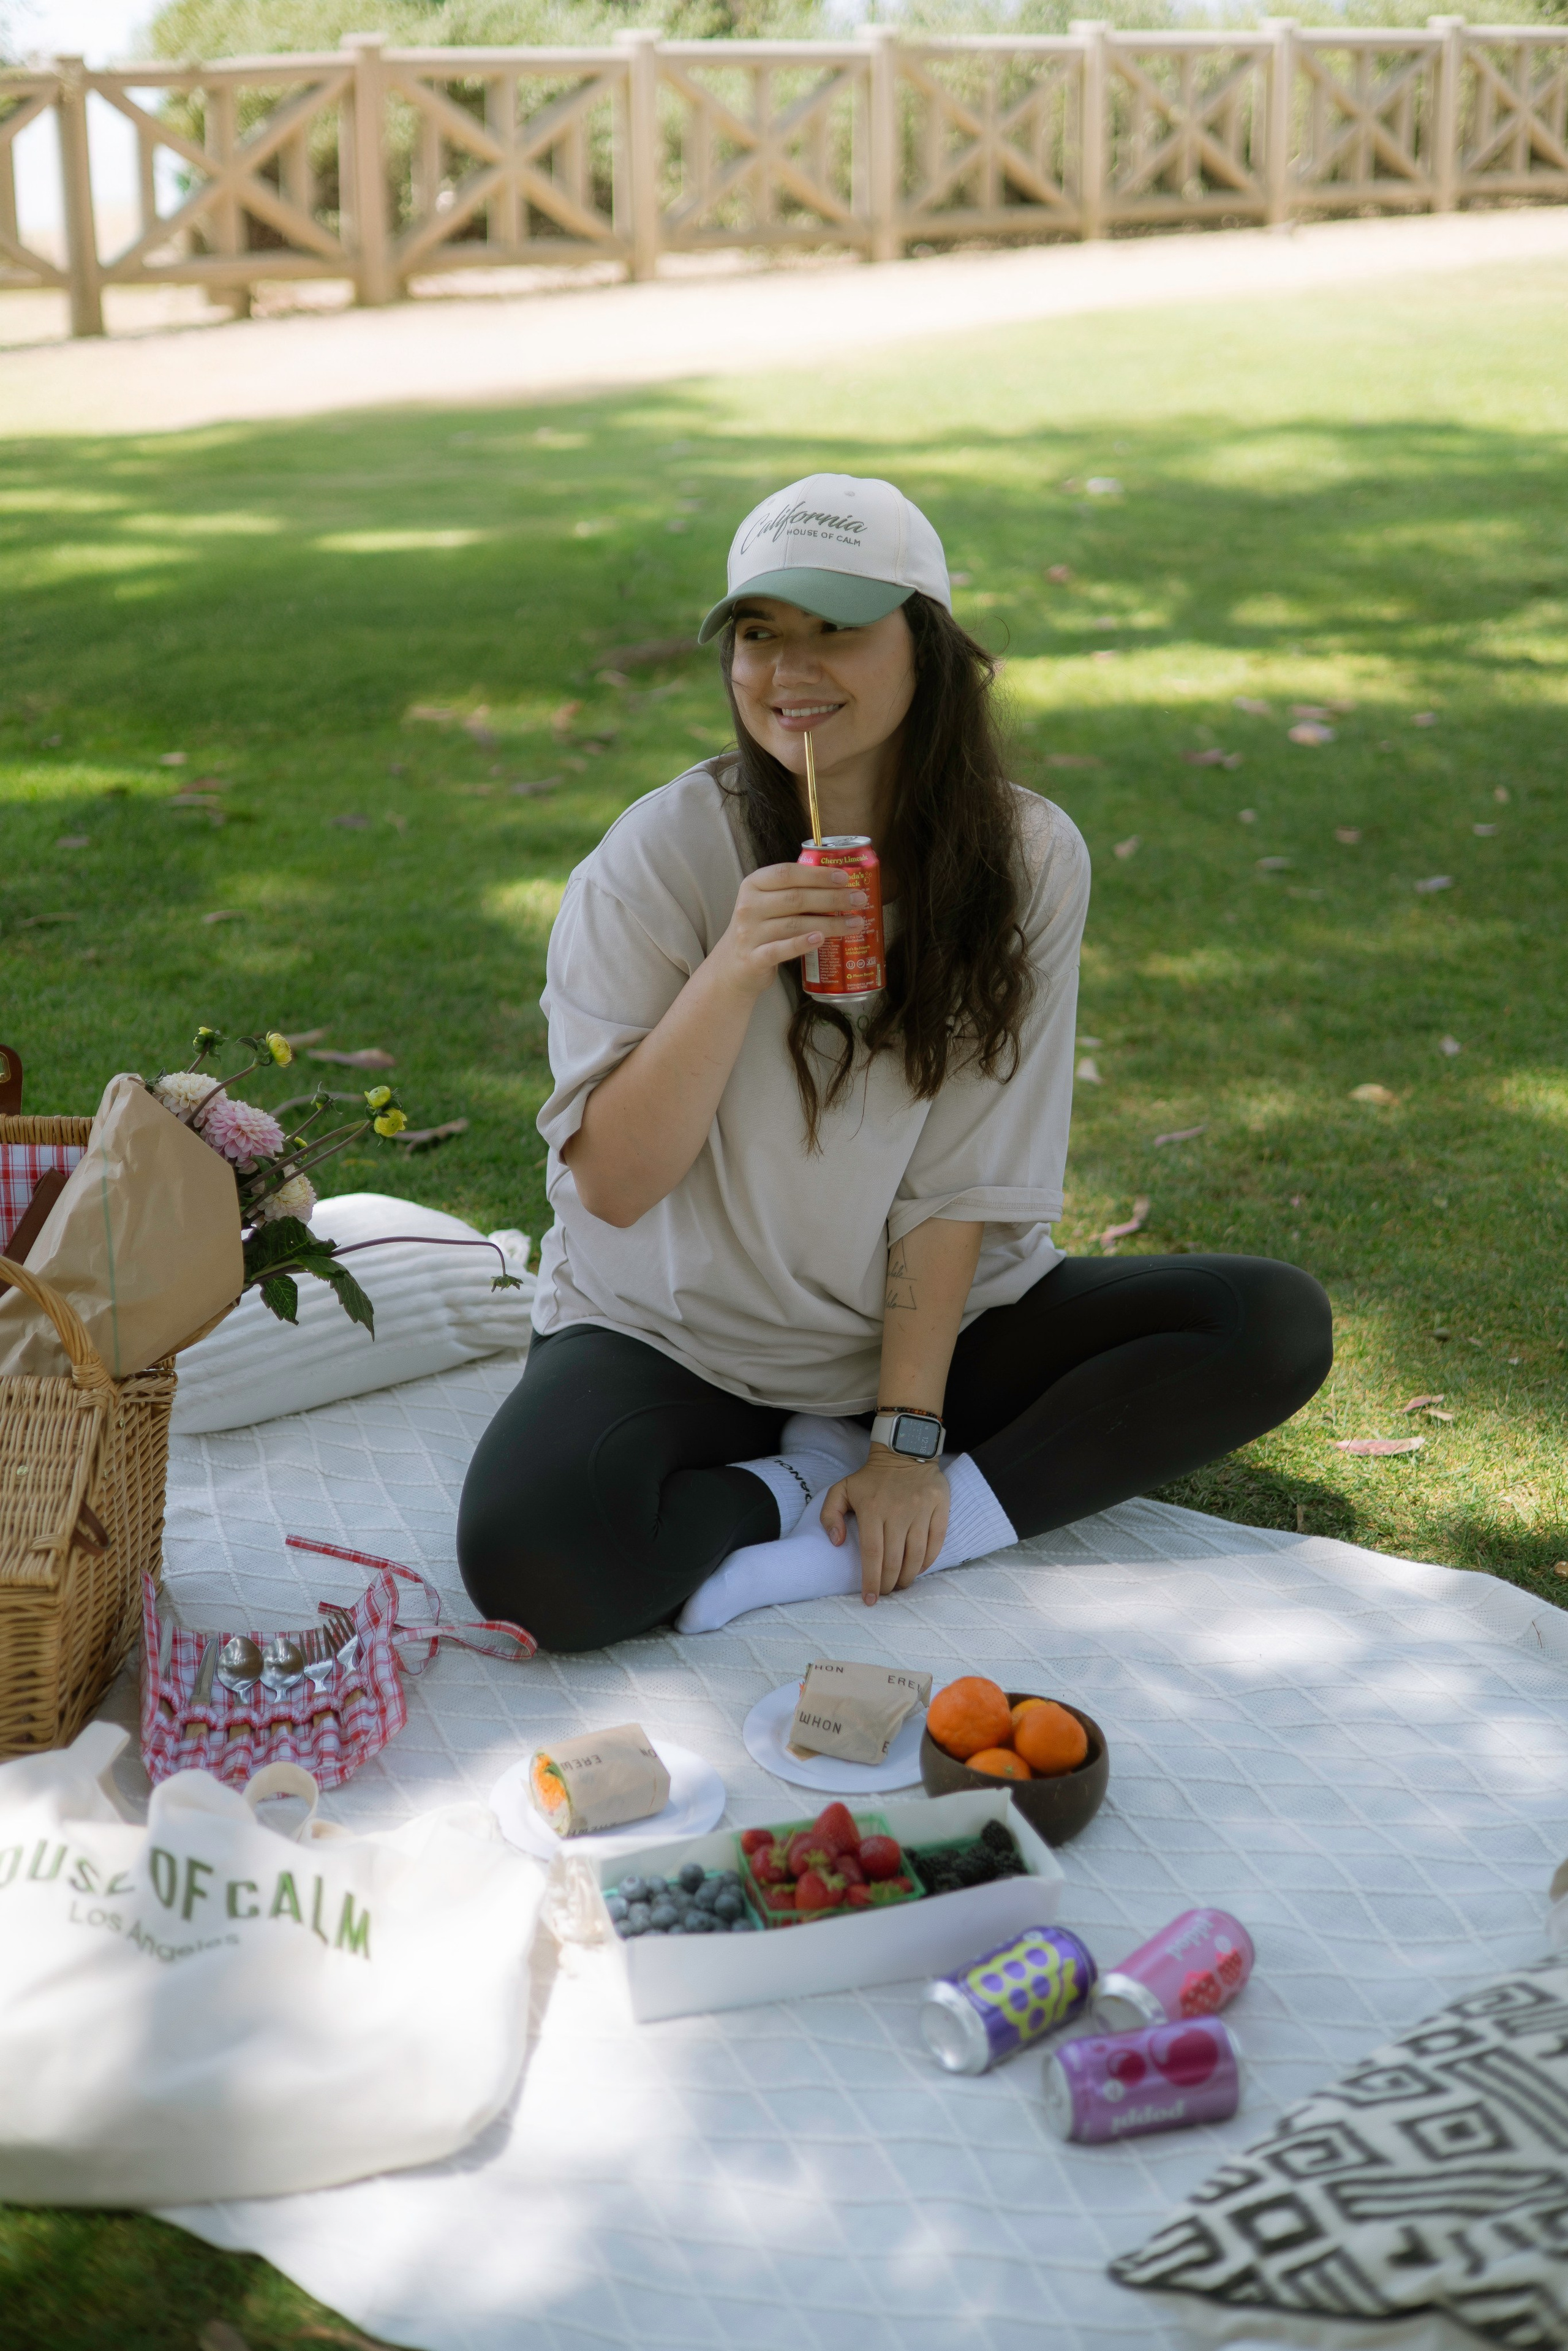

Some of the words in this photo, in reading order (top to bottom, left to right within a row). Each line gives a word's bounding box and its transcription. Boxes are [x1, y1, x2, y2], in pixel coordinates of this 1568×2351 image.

[740, 501, 867, 554] California
[787, 529, 818, 538] HOUSE
[836, 535, 861, 546] CALM
[844, 854, 869, 863] Limeade
[888, 1261, 903, 1279] hale
[919, 1436, 929, 1454] 12:18
[814, 1664, 844, 1674] HON
[149, 1846, 214, 1922] OF
[226, 1870, 371, 1960] CALM
[69, 1900, 122, 1931] Los
[126, 1919, 239, 1963] Angeles
